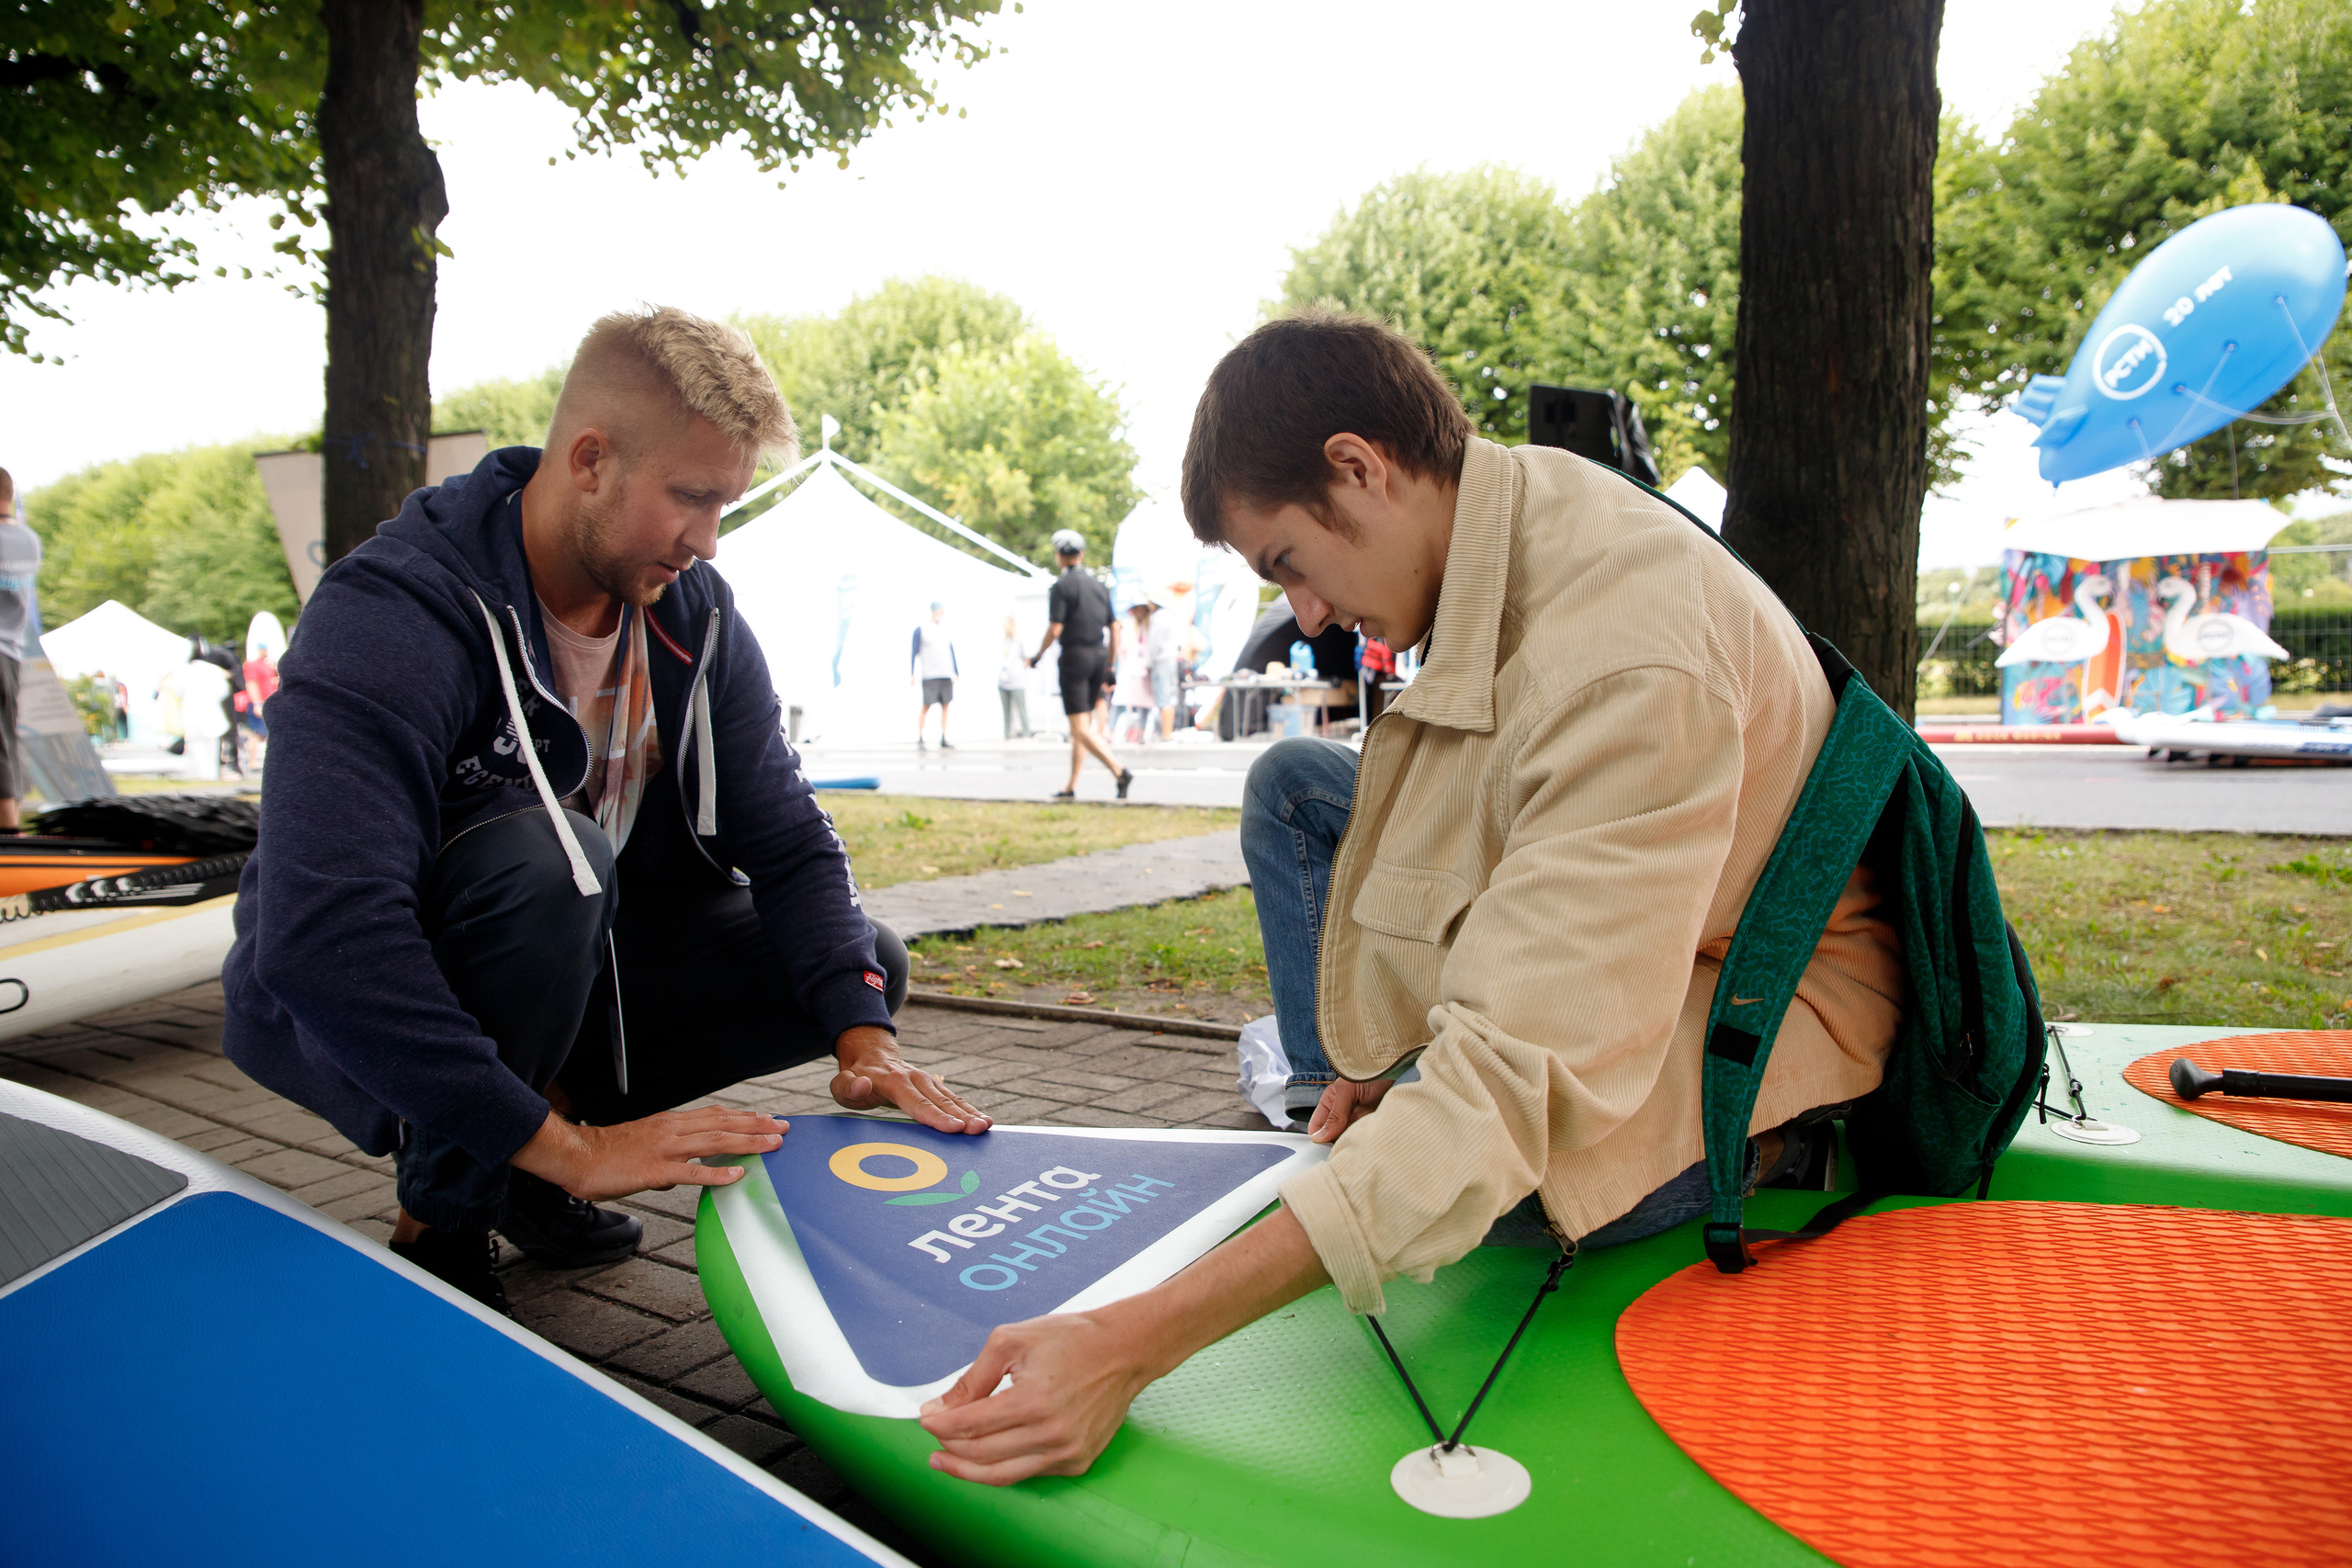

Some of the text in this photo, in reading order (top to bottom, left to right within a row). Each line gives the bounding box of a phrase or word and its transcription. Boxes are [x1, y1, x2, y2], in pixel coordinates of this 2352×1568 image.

[2163, 296, 2195, 327] 20
[908, 1166, 1102, 1264] лента
[959, 1174, 1175, 1291] онлайн
